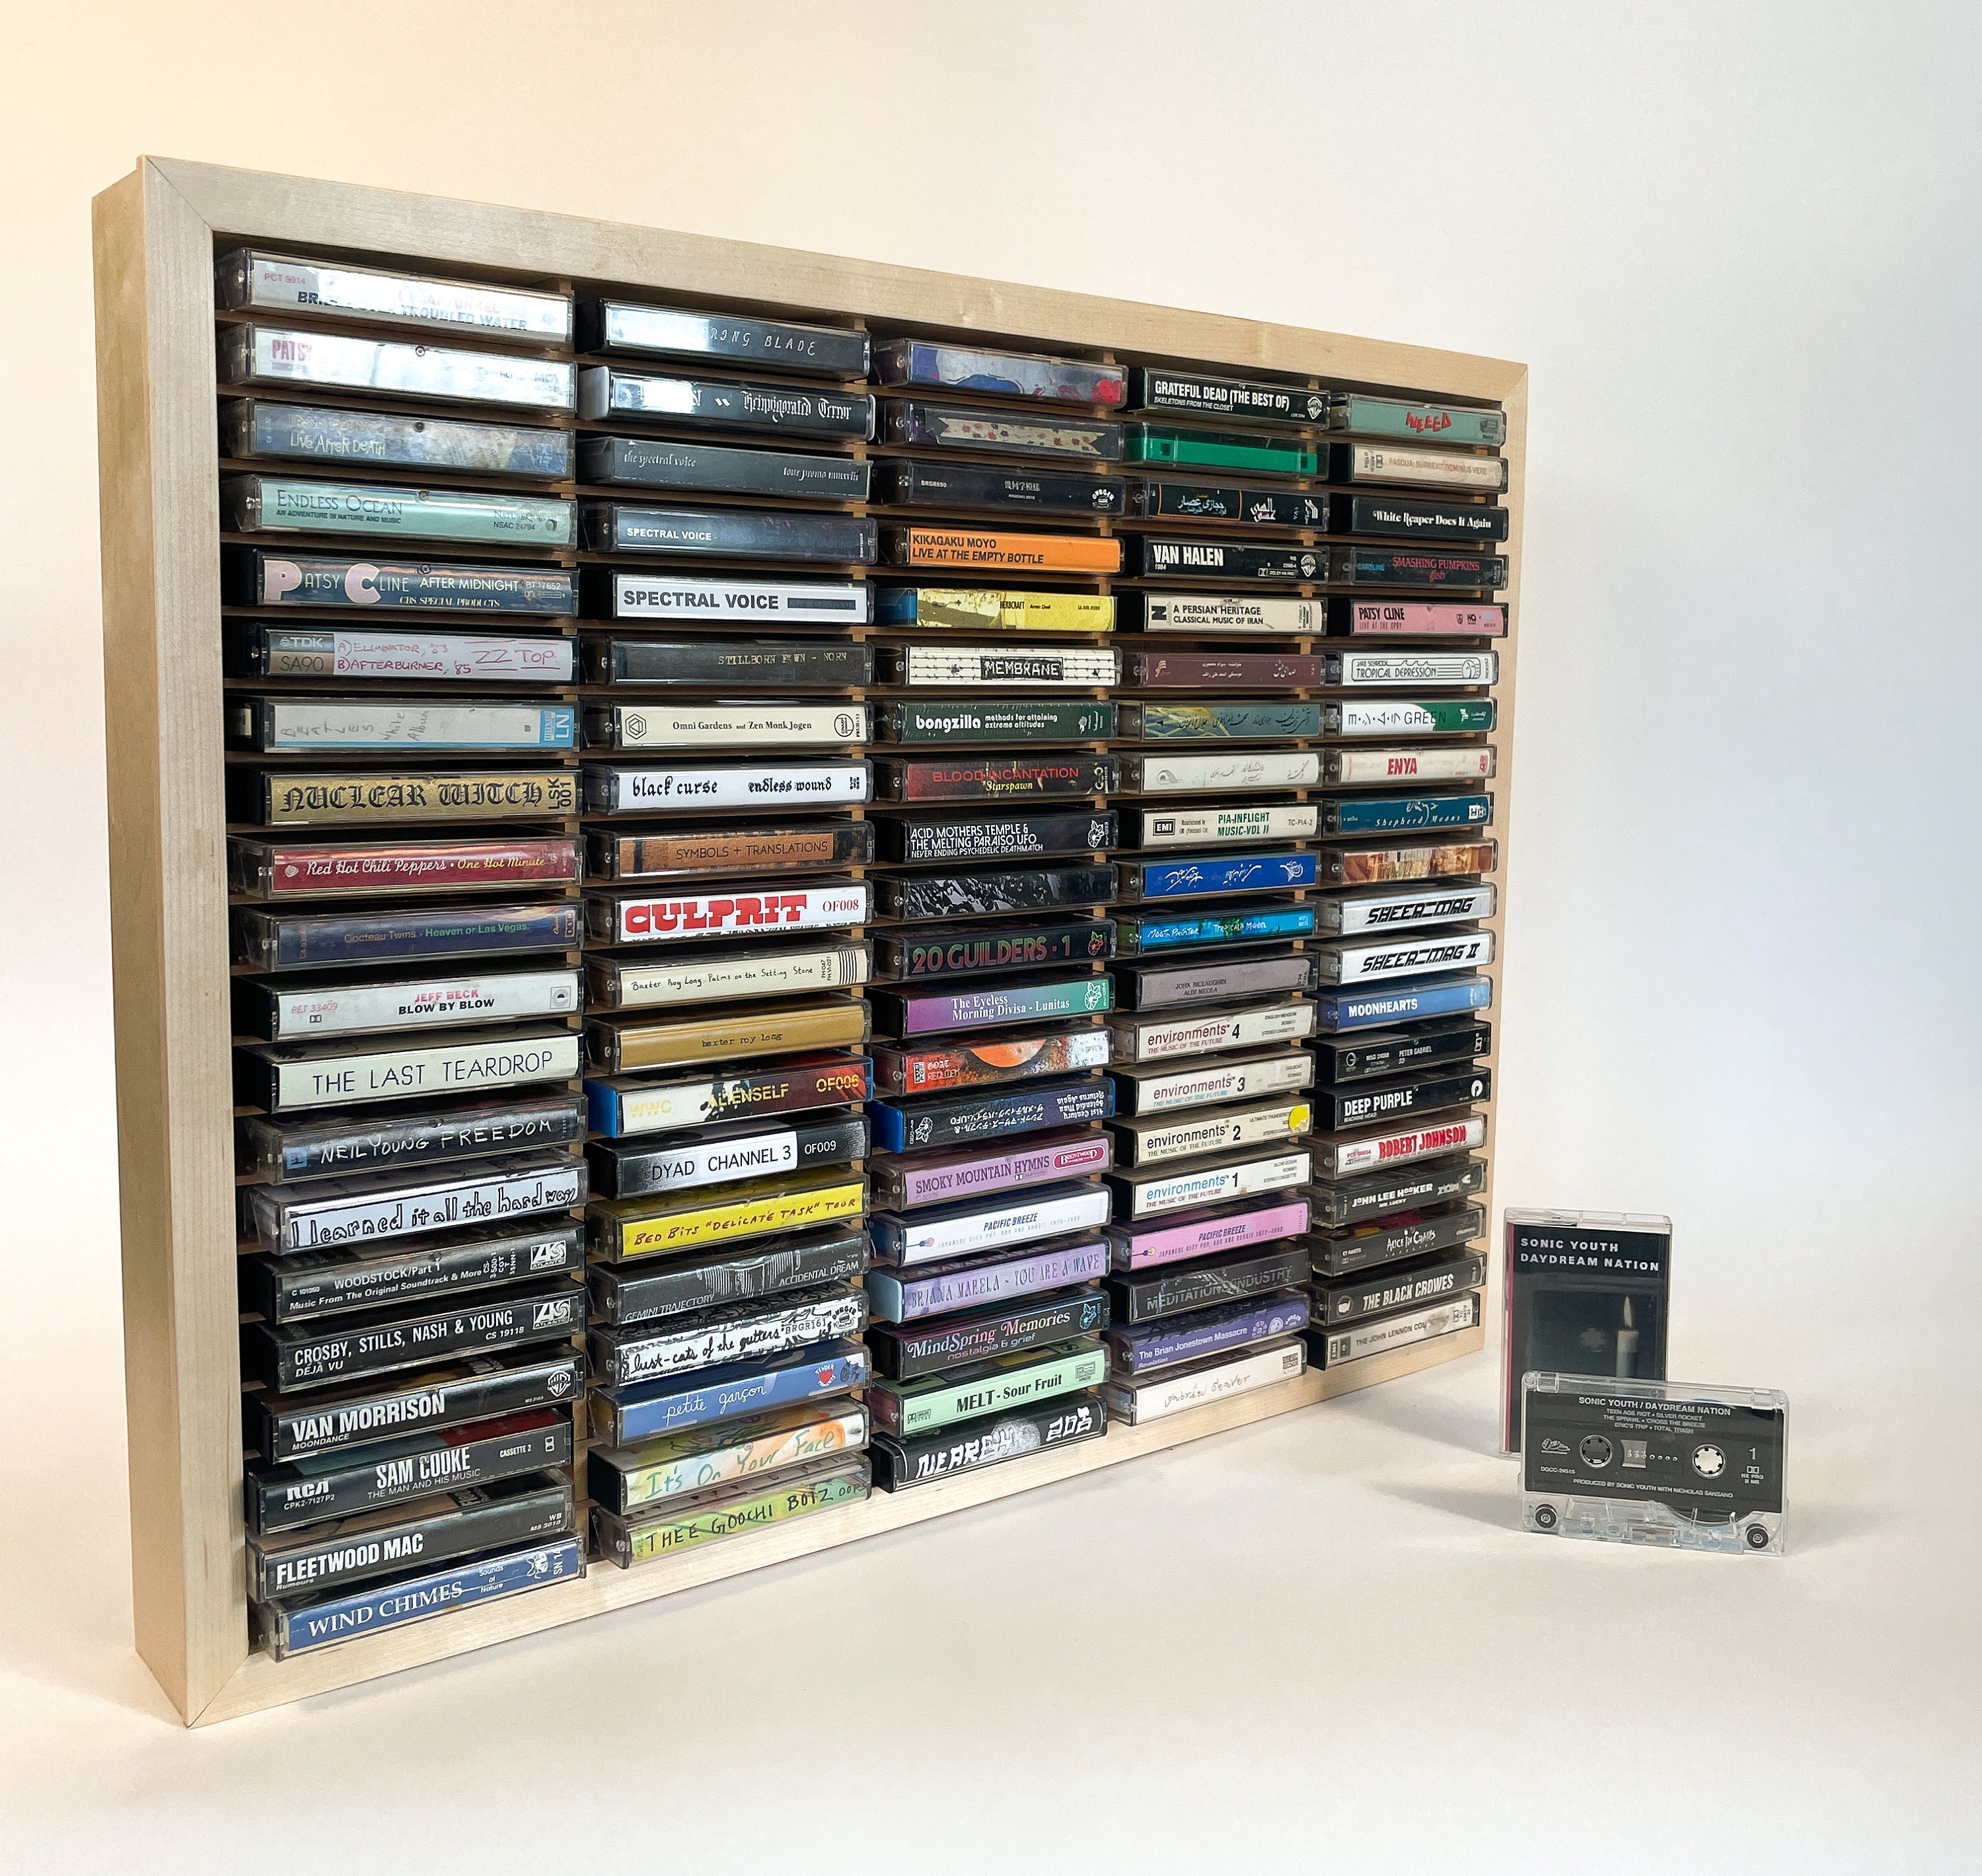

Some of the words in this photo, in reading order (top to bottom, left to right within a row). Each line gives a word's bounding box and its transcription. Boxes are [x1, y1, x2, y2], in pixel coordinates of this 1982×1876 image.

[1155, 381, 1201, 398] GRATEFUL
[1204, 387, 1227, 401] DEAD
[1230, 389, 1250, 404] (THE
[1252, 392, 1272, 407] BEST
[1275, 395, 1290, 412] OF)
[277, 490, 338, 509] ENDLESS
[346, 494, 402, 514] OCEAN
[627, 528, 679, 539] SPECTRAL
[682, 531, 712, 541] VOICE
[913, 535, 964, 546] KIKAGAKU
[967, 538, 996, 548] MOYO
[913, 548, 934, 558] LIVE
[936, 549, 949, 558] AT
[951, 550, 969, 560] THE
[972, 551, 1005, 562] EMPTY
[1008, 553, 1044, 564] BOTTLE
[1153, 545, 1179, 564] VAN
[1183, 547, 1223, 566] HALEN
[1392, 556, 1436, 569] SMASHING
[1438, 559, 1479, 571] PUMPKINS
[264, 560, 340, 601] PATSY
[345, 563, 409, 603] CLINE
[420, 577, 455, 589] AFTER
[459, 579, 518, 591] MIDNIGHT
[624, 590, 719, 608] SPECTRAL
[725, 595, 778, 609] VOICE
[1183, 605, 1217, 614] PERSIAN
[1221, 606, 1261, 615] HERITAGE
[1358, 607, 1380, 620] PATSY
[1384, 608, 1405, 620] CLINE
[291, 638, 324, 648] TDK
[280, 656, 324, 672] SA90
[1357, 667, 1391, 677] TROPICAL
[1395, 667, 1436, 677] DEPRESSION
[673, 722, 696, 730] Omni
[698, 722, 733, 730] Gardens
[749, 721, 763, 730] Zen
[766, 721, 788, 730] Monk
[789, 721, 812, 732] Jogen
[916, 714, 980, 733] bongzilla
[1405, 712, 1446, 724] GREEN
[933, 770, 984, 782] BLOOD
[988, 767, 1079, 780] INCANTATION
[1387, 758, 1417, 775] ENYA
[677, 780, 717, 794] curse
[986, 780, 1033, 792] Starspawn
[280, 784, 425, 812] NUCLEAR
[911, 827, 934, 839] ACID
[937, 825, 982, 838] MOTHERS
[985, 824, 1021, 835] TEMPLE
[677, 846, 729, 859] SYMBOLS
[746, 842, 828, 856] TRANSLATIONS
[911, 839, 928, 850] THE
[932, 837, 971, 848] MELTING
[974, 835, 1014, 846] PARAISO
[1017, 834, 1037, 844] UFO
[307, 861, 332, 875] Red
[336, 861, 359, 874] Hot
[363, 859, 391, 873] Chili
[394, 859, 447, 874] Peppers
[458, 858, 480, 870] One
[484, 857, 504, 868] Hot
[507, 856, 546, 867] Minute
[625, 895, 807, 933] CULPRIT
[823, 899, 859, 912] OF008
[388, 930, 416, 939] Twins
[425, 926, 462, 937] Heaven
[478, 924, 495, 933] Las
[498, 923, 527, 933] Vegas
[414, 992, 443, 1002] JEFF
[447, 989, 479, 1000] BECK
[951, 998, 970, 1010] The
[973, 994, 1008, 1007] Eyeless
[398, 1004, 434, 1014] BLOW
[439, 1002, 455, 1011] BY
[459, 998, 494, 1009] BLOW
[953, 1006, 994, 1021] Morning
[998, 1003, 1026, 1016] Divisa
[1035, 998, 1070, 1012] Lunitas
[1348, 998, 1418, 1018] MOONHEARTS
[312, 1071, 355, 1094] THE
[370, 1065, 425, 1088] LAST
[443, 1051, 552, 1081] TEARDROP
[1344, 1098, 1371, 1116] DEEP
[1374, 1090, 1413, 1111] PURPLE
[320, 1142, 367, 1163] NEIL
[369, 1135, 429, 1157] YOUNG
[441, 1121, 551, 1148] FREEDOM
[805, 1141, 836, 1154] OF009
[1379, 1135, 1417, 1159] ROBERT
[1419, 1125, 1466, 1150] JOHNSON
[652, 1160, 694, 1180] DYAD
[708, 1150, 778, 1172] CHANNEL
[783, 1146, 790, 1160] 3
[916, 1175, 953, 1193] SMOKY
[956, 1162, 1012, 1186] MOUNTAIN
[1014, 1156, 1050, 1174] HYMNS
[1521, 1238, 1563, 1248] SONIC
[1570, 1240, 1618, 1252] YOUTH
[1521, 1254, 1597, 1265] DAYDREAM
[1604, 1258, 1659, 1271] NATION
[1363, 1294, 1380, 1310] THE
[1382, 1284, 1413, 1306] BLACK
[1414, 1273, 1453, 1298] CROWES
[295, 1341, 351, 1364] CROSBY,
[359, 1331, 406, 1353] STILLS,
[413, 1322, 447, 1342] NASH
[455, 1320, 463, 1333] &
[469, 1310, 513, 1331] YOUNG
[486, 1332, 497, 1341] CS
[499, 1326, 524, 1337] 19118
[1139, 1351, 1152, 1359] The
[1154, 1347, 1173, 1356] Brian
[1175, 1335, 1212, 1351] Jonestown
[1214, 1327, 1247, 1341] Massacre
[957, 1389, 996, 1413] MELT
[1003, 1383, 1031, 1400] Sour
[1035, 1374, 1062, 1390] Fruit
[662, 1396, 706, 1426] petite
[1579, 1397, 1605, 1406] SONIC
[1608, 1399, 1638, 1408] YOUTH
[1646, 1402, 1695, 1413] DAYDREAM
[1697, 1406, 1731, 1415] NATION
[292, 1415, 333, 1443] VAN
[339, 1394, 445, 1432] MORRISON
[292, 1434, 349, 1450] MOONDANCE
[377, 1458, 414, 1489] SAM
[420, 1446, 470, 1479] COOKE
[367, 1490, 385, 1499] THE
[388, 1484, 410, 1495] MAN
[412, 1480, 431, 1490] AND
[435, 1476, 449, 1485] HIS
[453, 1468, 480, 1482] MUSIC
[277, 1544, 379, 1584] FLEETWOOD
[384, 1533, 423, 1560] MAC
[309, 1607, 373, 1636] WIND
[379, 1581, 463, 1617] CHIMES
